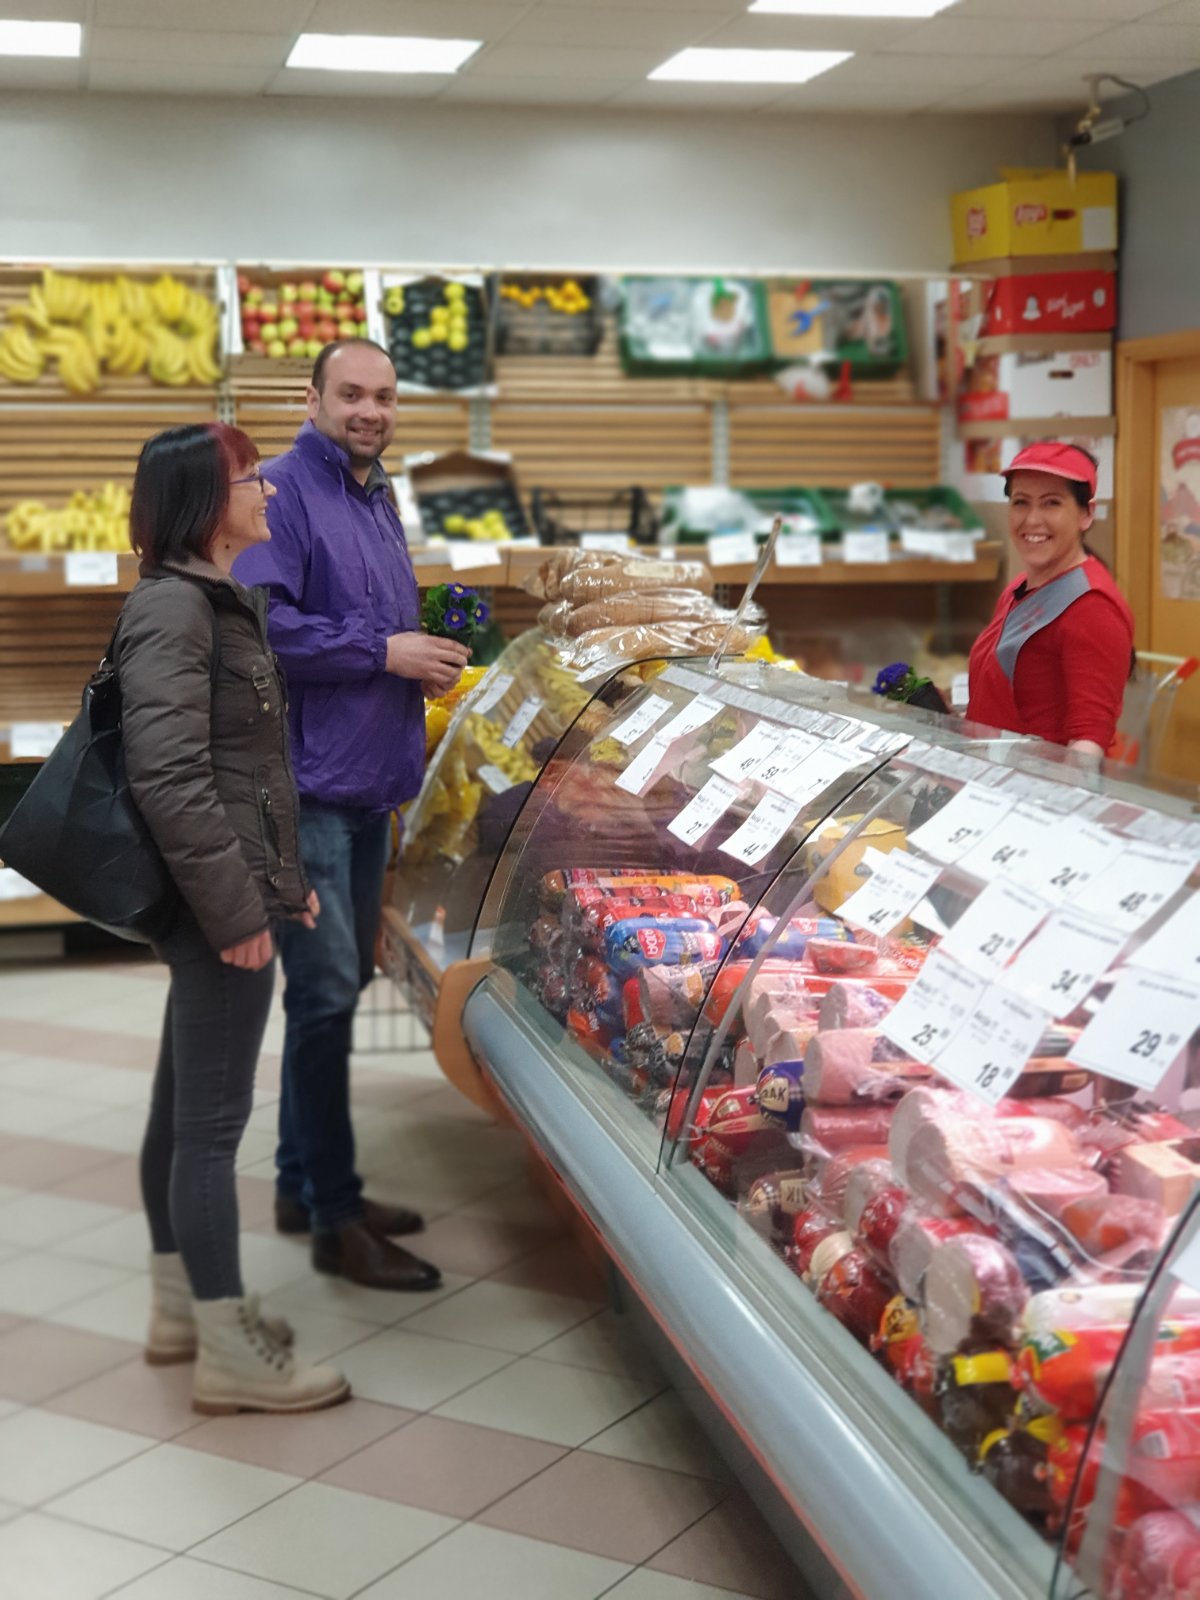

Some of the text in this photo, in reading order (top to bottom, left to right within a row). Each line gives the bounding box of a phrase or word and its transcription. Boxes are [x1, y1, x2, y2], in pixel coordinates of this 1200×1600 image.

[948, 827, 972, 843] 57
[743, 842, 760, 856] 44
[991, 845, 1017, 864] 64
[1050, 867, 1078, 886] 24
[1119, 891, 1148, 912] 48
[867, 908, 890, 925] 44
[979, 933, 1005, 956] 23
[1051, 969, 1080, 993] 34
[911, 1023, 938, 1046] 25
[1129, 1029, 1162, 1057] 29
[975, 1062, 1001, 1088] 18
